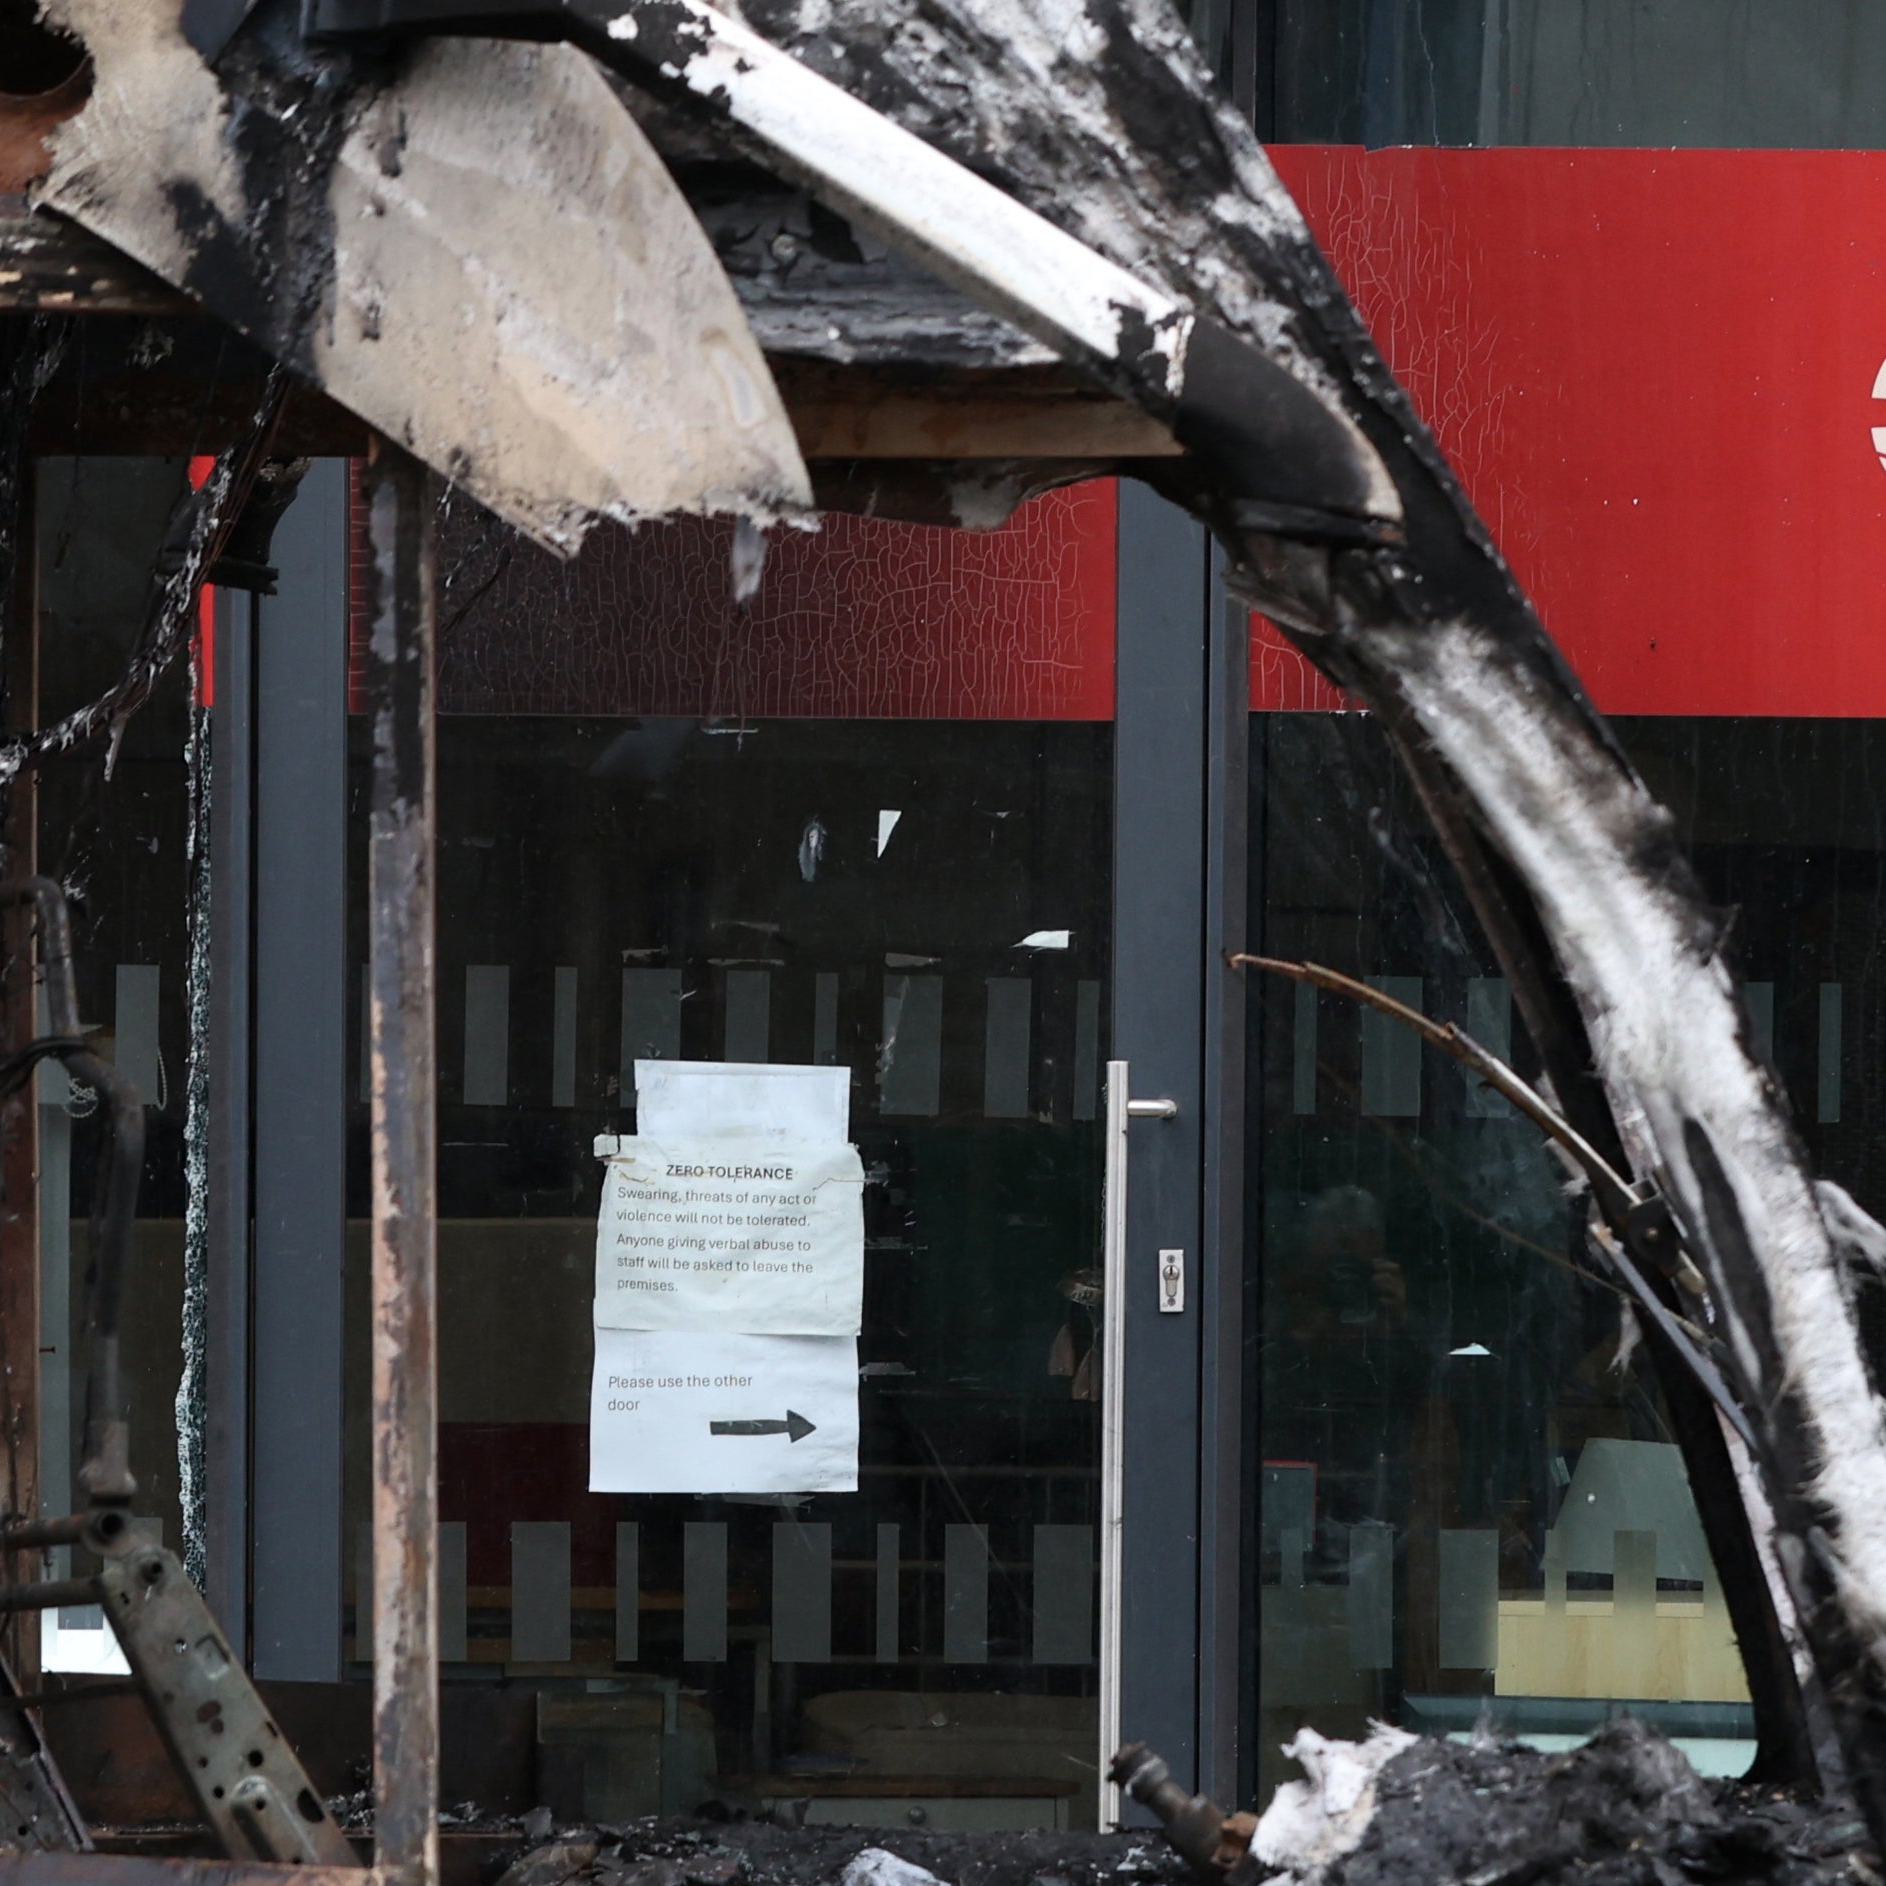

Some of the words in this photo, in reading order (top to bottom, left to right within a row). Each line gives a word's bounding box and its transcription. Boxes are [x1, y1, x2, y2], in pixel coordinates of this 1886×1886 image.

[666, 1164, 704, 1177] ZERO
[707, 1165, 793, 1180] TOLERANCE
[617, 1187, 681, 1202] Swearing,
[685, 1190, 733, 1203] threats
[736, 1191, 749, 1204] of
[752, 1194, 775, 1206] any
[779, 1194, 800, 1206] act
[617, 1210, 671, 1223] violence
[675, 1212, 697, 1224] will
[701, 1212, 723, 1225] not
[727, 1213, 743, 1226] be
[747, 1214, 810, 1227] tolerated.
[617, 1234, 664, 1248] Anyone
[667, 1236, 706, 1250] giving
[708, 1236, 750, 1251] verbal
[753, 1238, 794, 1251] abuse
[798, 1239, 811, 1251] to
[617, 1256, 645, 1268] staff
[648, 1257, 670, 1270] will
[673, 1258, 690, 1270] be
[693, 1259, 733, 1272] asked
[736, 1260, 750, 1272] to
[753, 1258, 788, 1273] leave
[792, 1260, 813, 1274] the
[617, 1278, 678, 1292] premises.
[609, 1376, 654, 1388] Please
[658, 1376, 683, 1388] use
[687, 1376, 710, 1388] the
[714, 1375, 753, 1388] other
[607, 1398, 641, 1412] door
